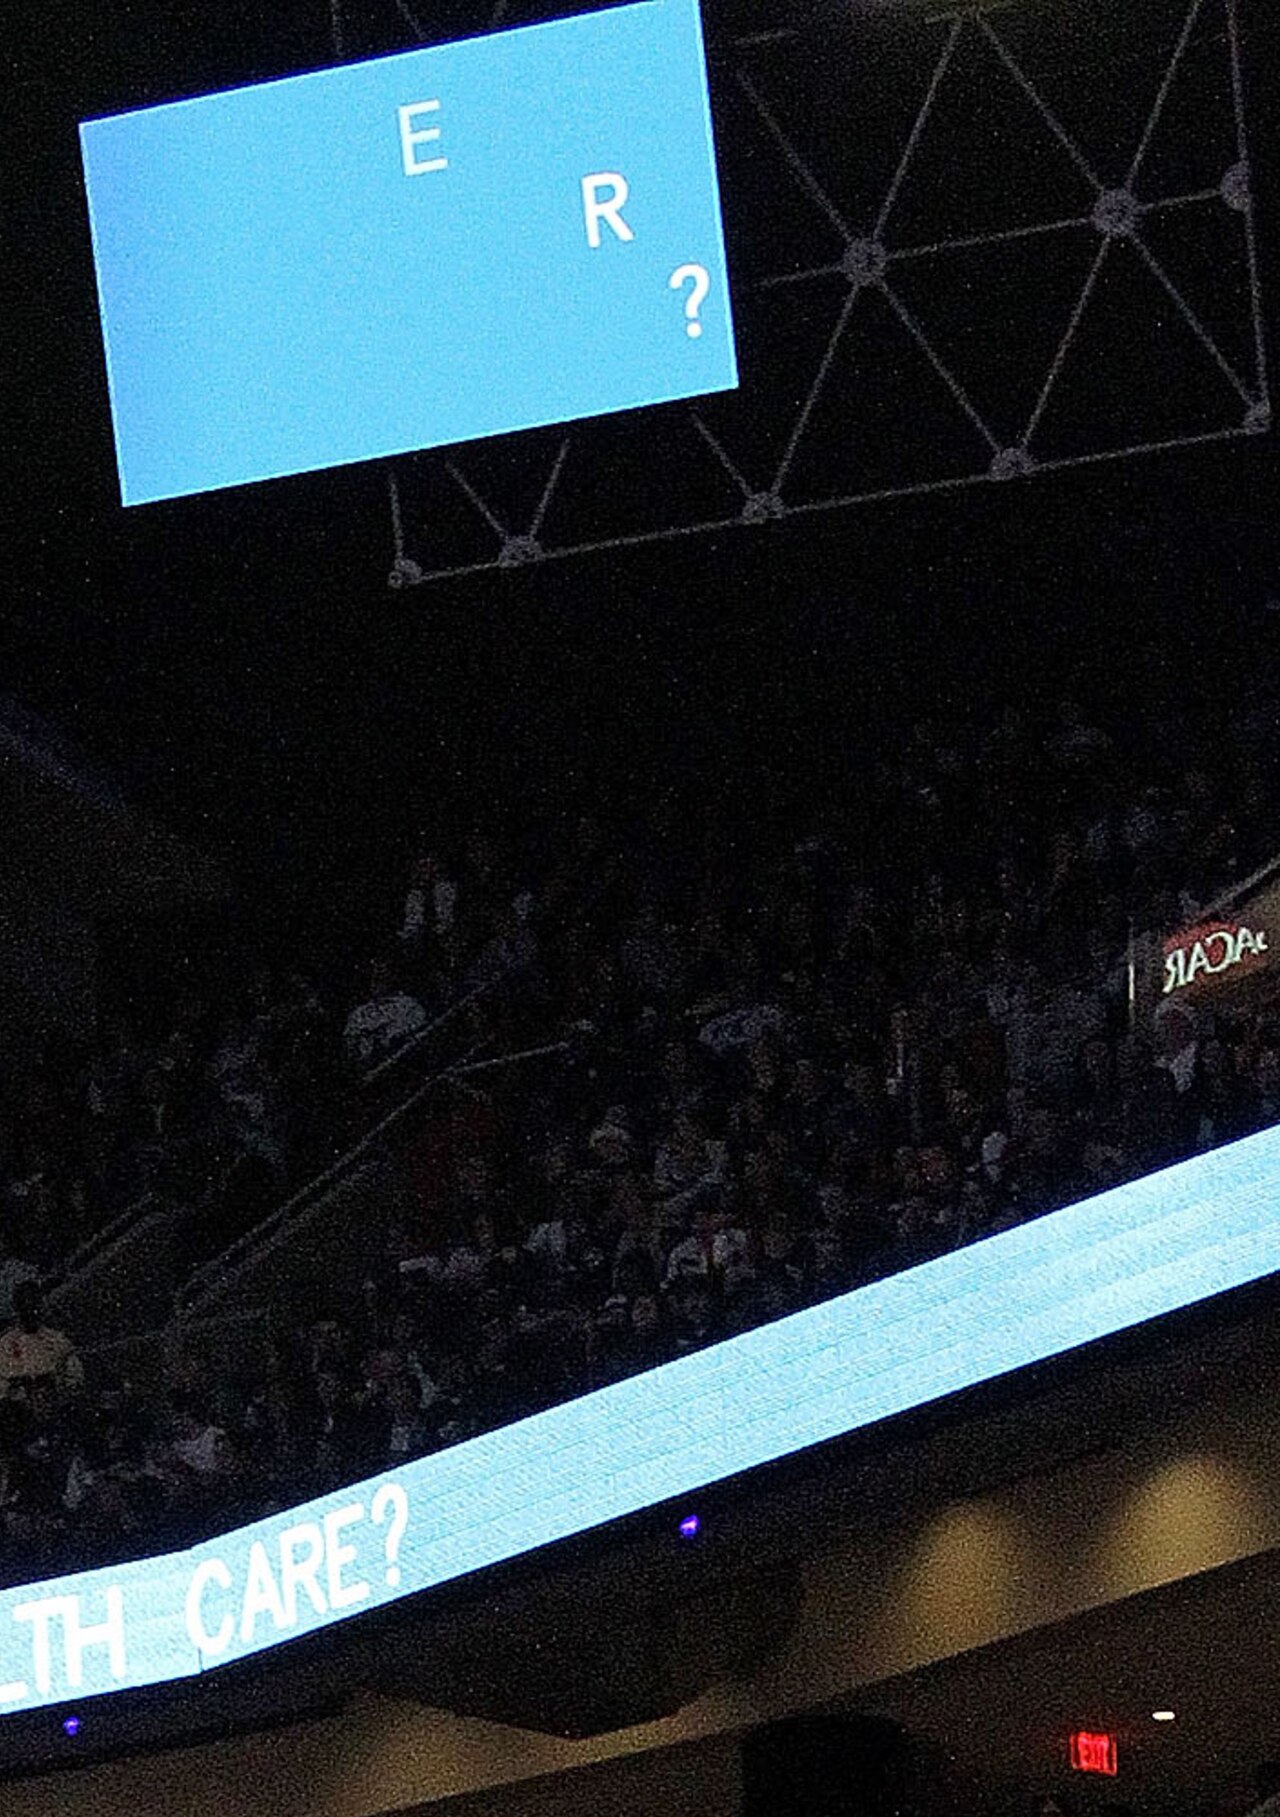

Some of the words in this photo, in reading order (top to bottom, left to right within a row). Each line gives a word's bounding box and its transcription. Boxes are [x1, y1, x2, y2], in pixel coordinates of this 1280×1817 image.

[397, 98, 449, 177] E
[579, 171, 634, 248] R
[669, 262, 711, 339] ?
[184, 1484, 410, 1656] CARE?
